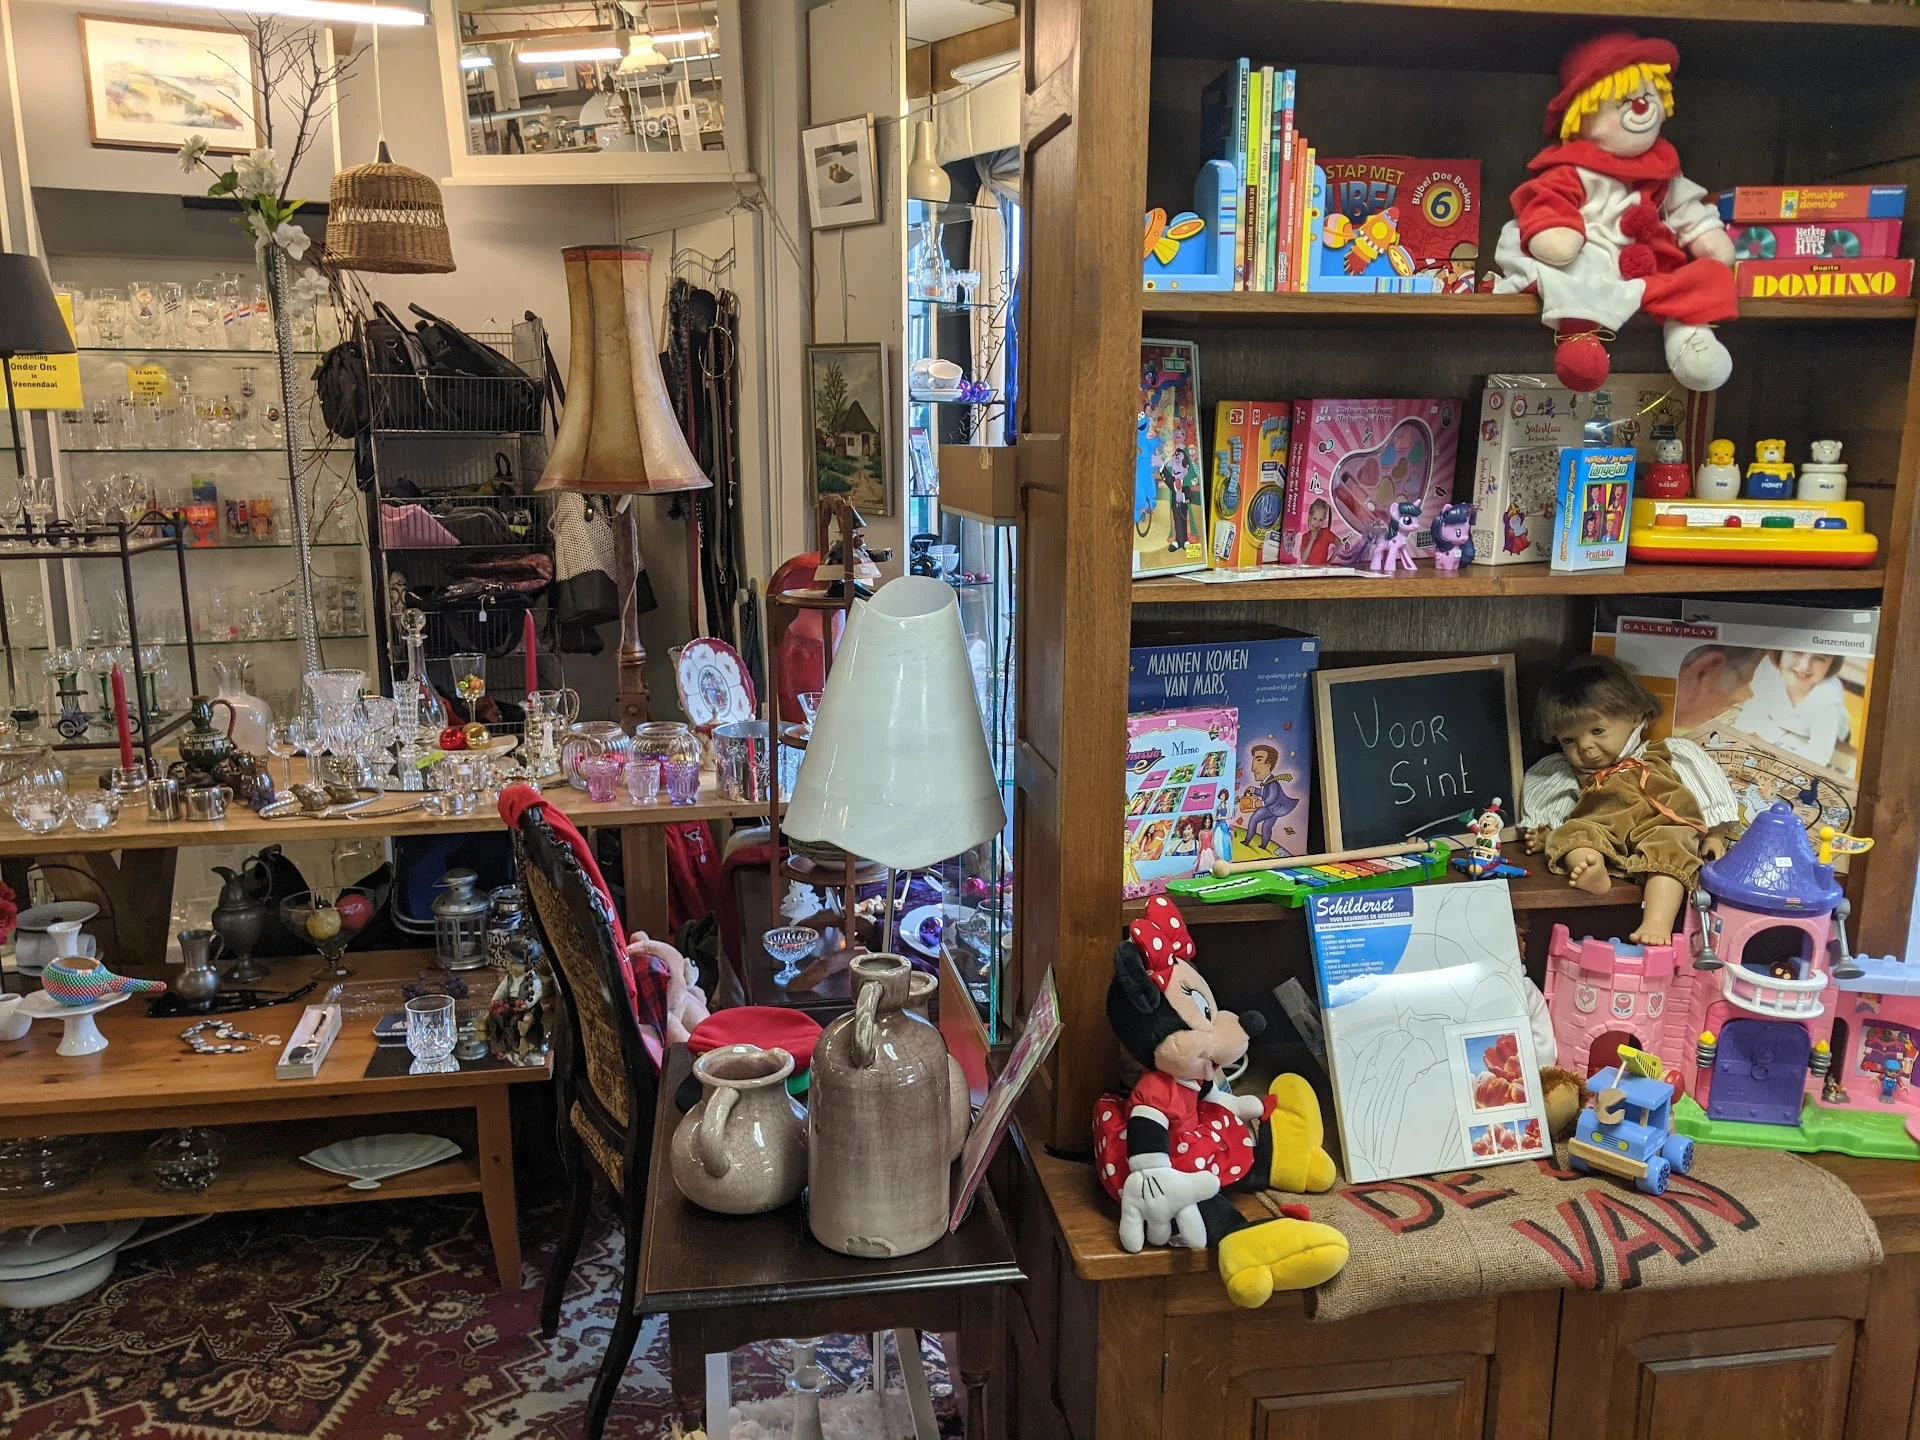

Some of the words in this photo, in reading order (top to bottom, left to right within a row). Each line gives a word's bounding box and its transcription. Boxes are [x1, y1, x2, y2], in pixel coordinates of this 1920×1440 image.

[1326, 165, 1367, 180] STAP
[1370, 165, 1405, 184] MET
[1412, 177, 1431, 205] Bijbel
[1433, 171, 1452, 181] Doe
[1454, 176, 1471, 212] Boeken
[1431, 190, 1452, 219] 6
[1800, 199, 1837, 209] domino
[1258, 215, 1266, 244] spaarpot
[1795, 224, 1826, 238] Herken
[1753, 272, 1897, 298] DOMINO
[10, 362, 38, 371] Onder
[40, 362, 58, 371] Ons
[1315, 415, 1332, 424] pcs
[1623, 622, 1681, 635] GALLERY
[1683, 627, 1716, 637] PLAY
[1812, 635, 1866, 649] Ganzenbord
[1147, 651, 1202, 676] MANNEN
[1205, 649, 1250, 671] KOMEN
[1164, 674, 1189, 698] VAN
[1193, 672, 1229, 697] MARS,
[1171, 740, 1200, 757] Memo
[1389, 753, 1475, 805] Sint
[1316, 896, 1395, 917] Schilderset
[486, 931, 511, 946] HOM
[1336, 1172, 1518, 1237] DE
[1509, 1173, 1761, 1292] VAN
